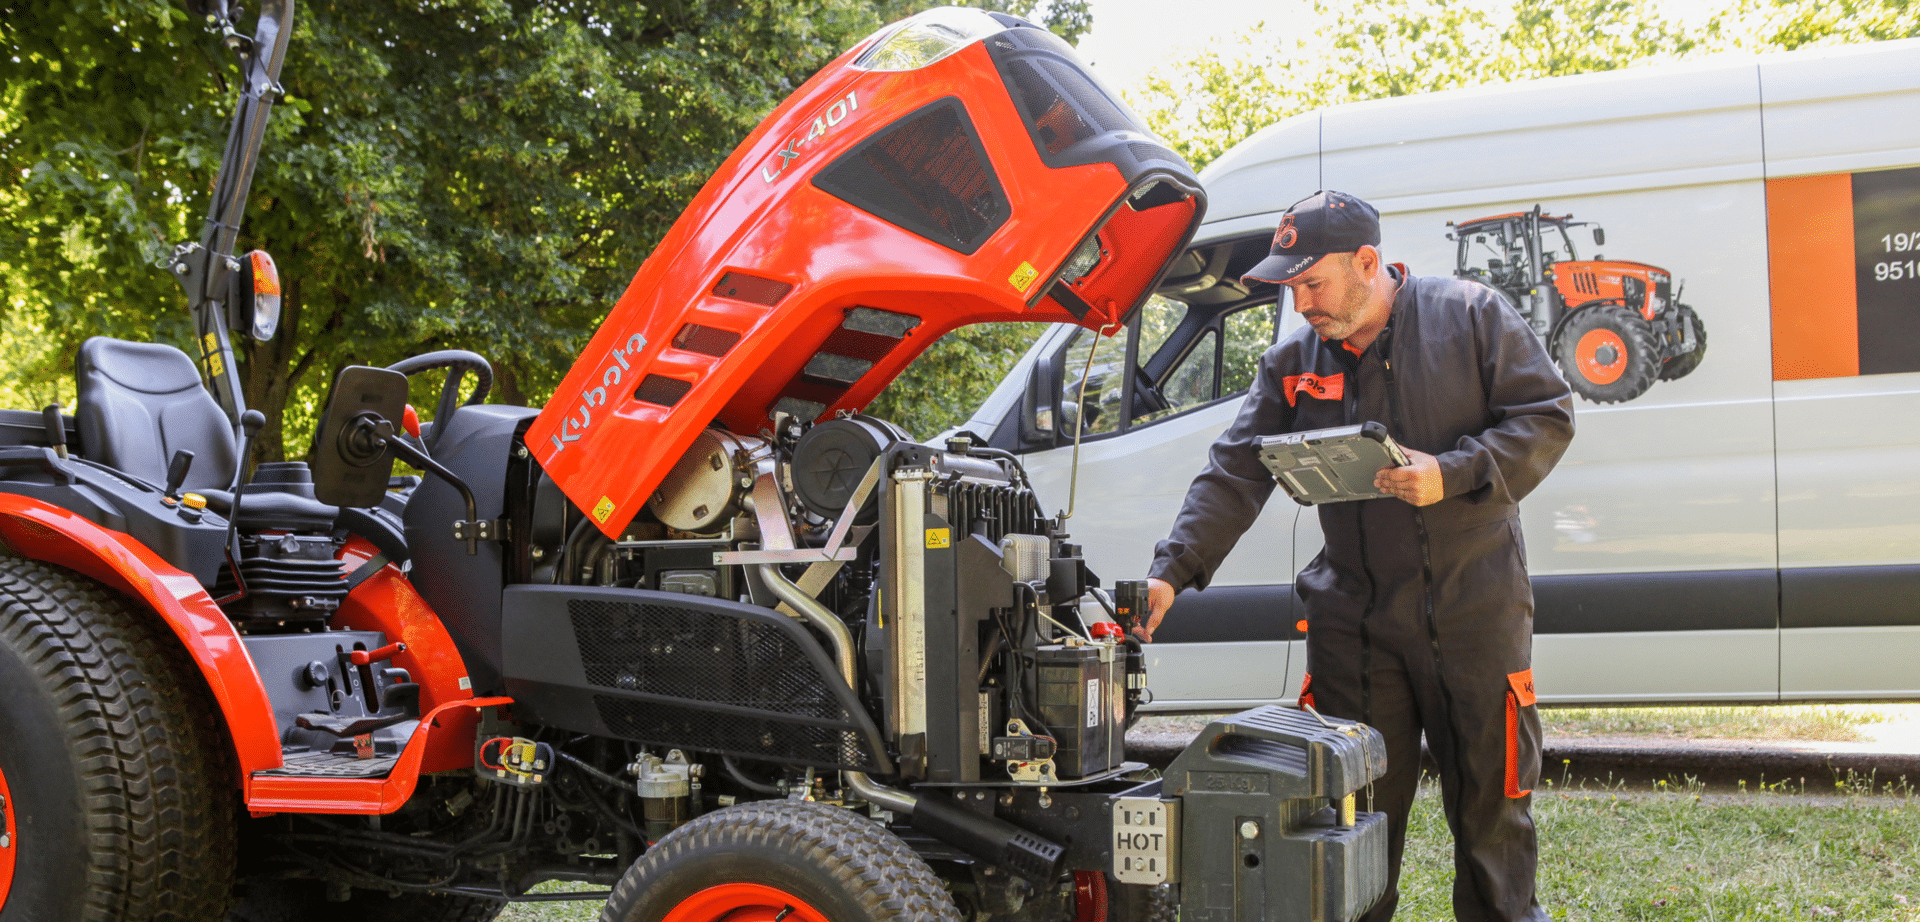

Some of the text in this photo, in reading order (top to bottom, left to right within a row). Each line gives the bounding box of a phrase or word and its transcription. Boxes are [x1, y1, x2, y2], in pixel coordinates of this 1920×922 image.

[761, 90, 859, 184] LX-401
[1874, 260, 1920, 281] 951
[551, 333, 647, 451] Kubota
[1117, 832, 1163, 851] HOT
